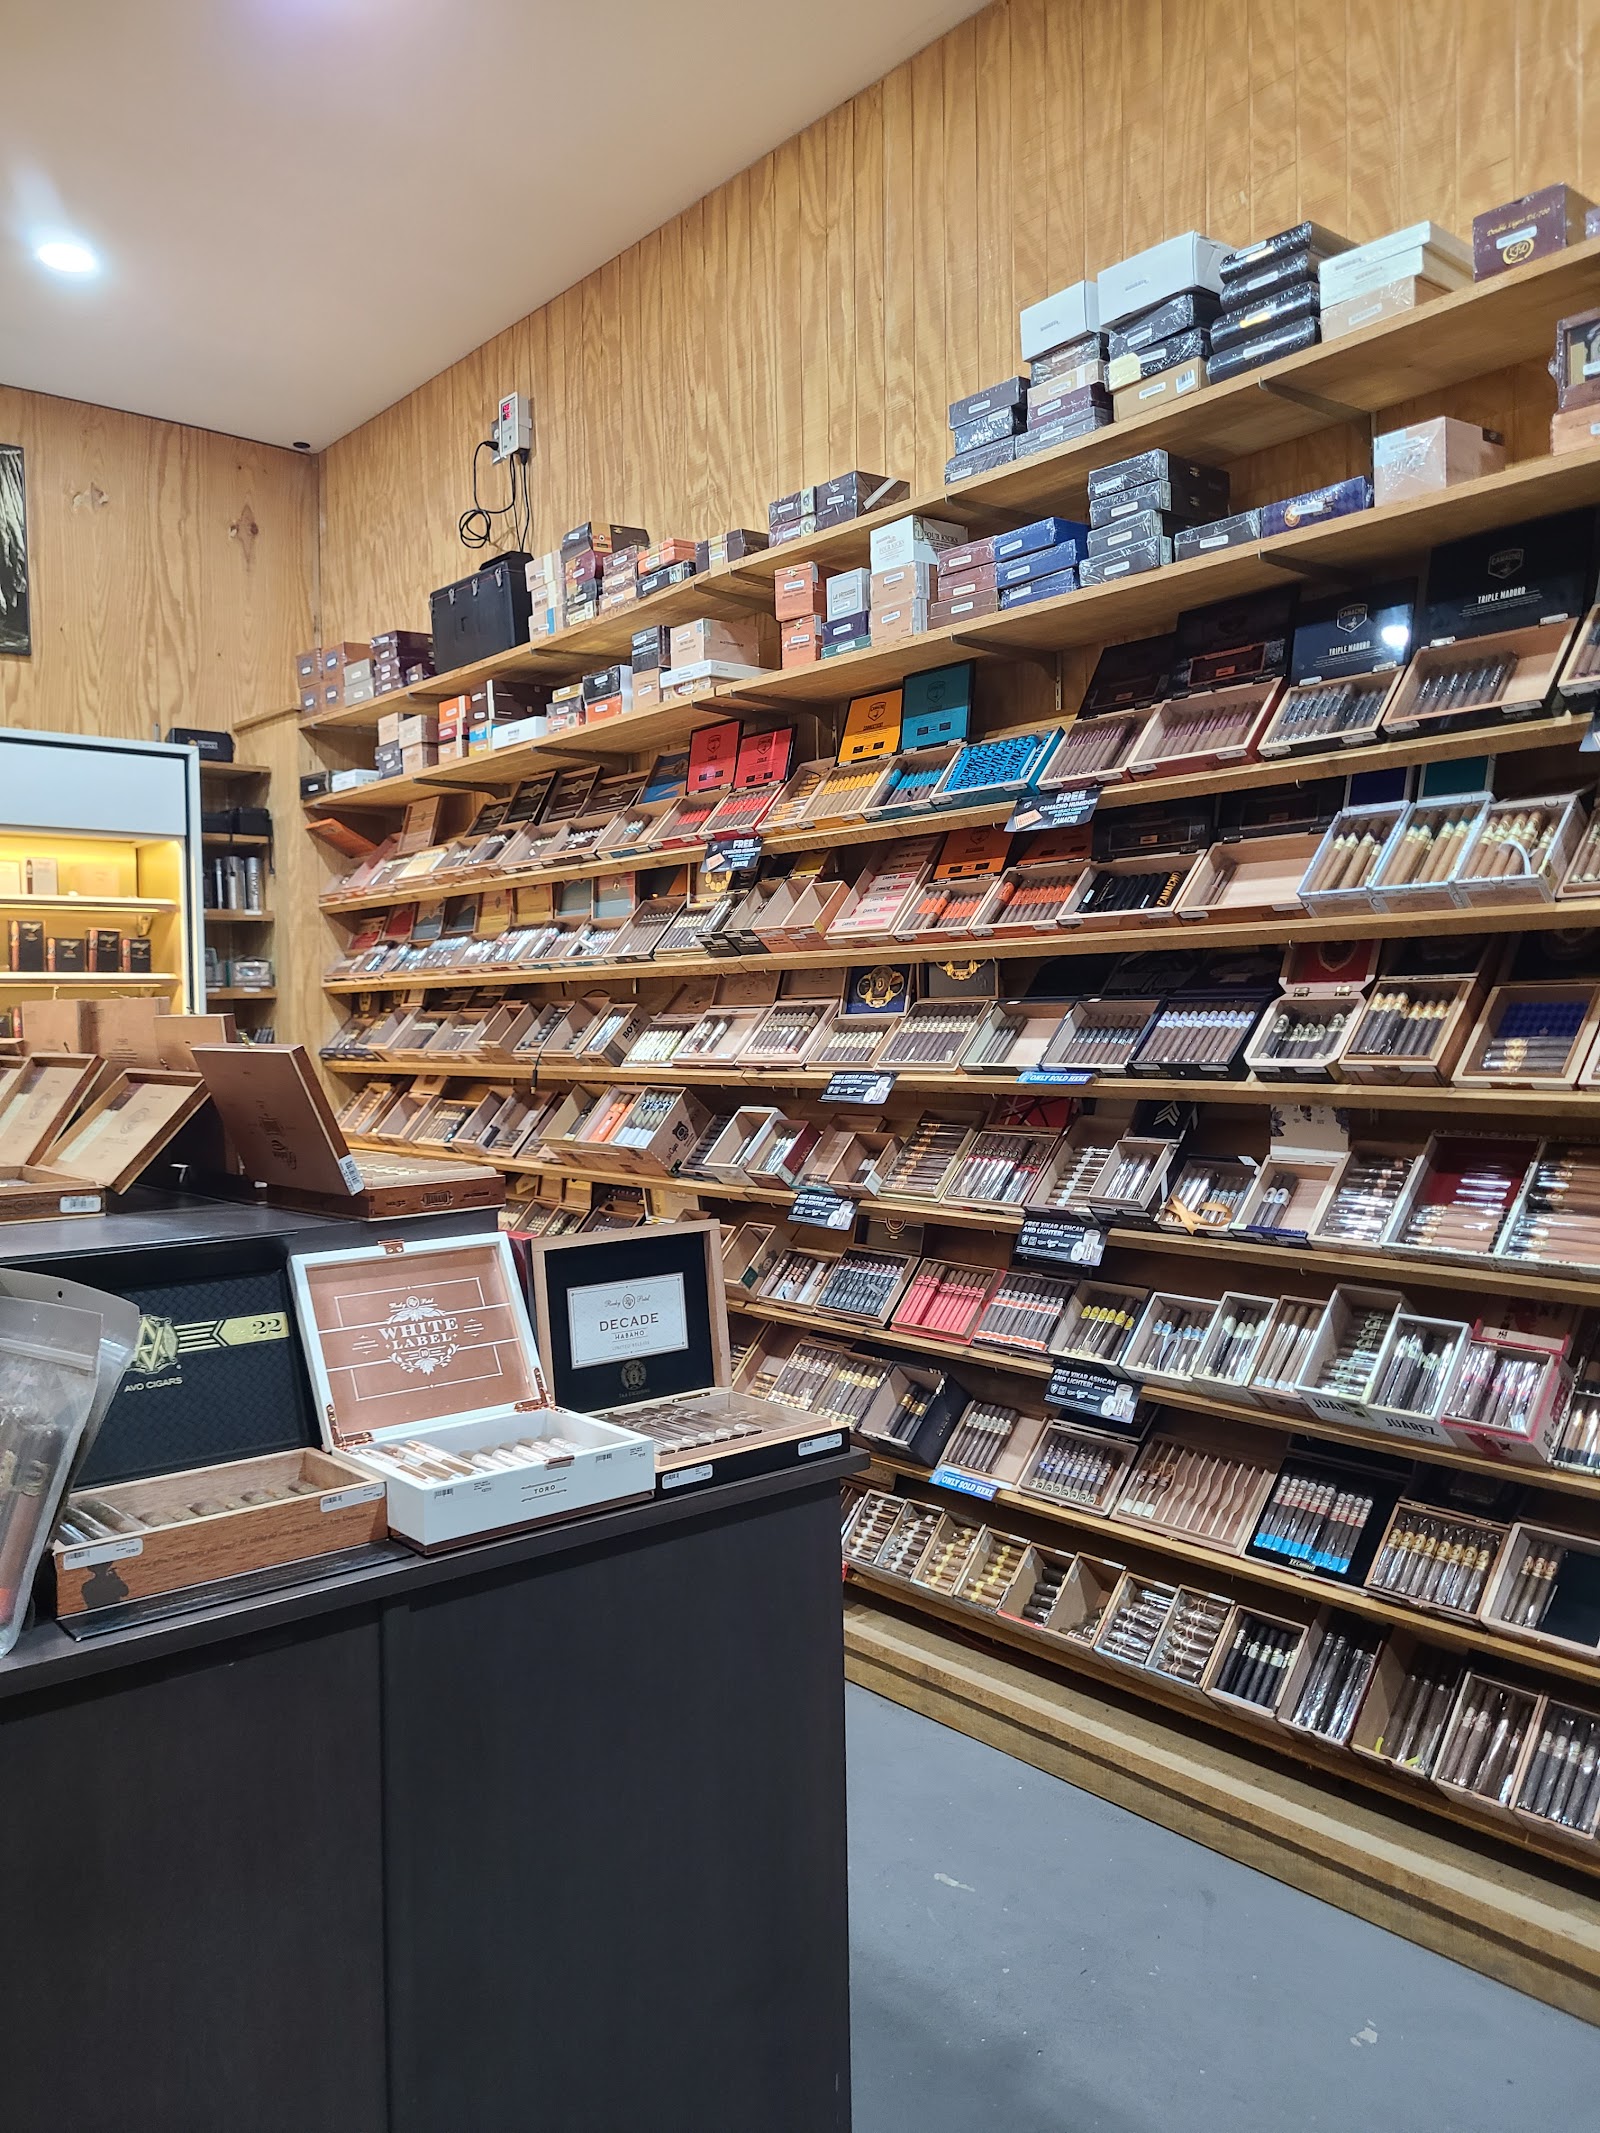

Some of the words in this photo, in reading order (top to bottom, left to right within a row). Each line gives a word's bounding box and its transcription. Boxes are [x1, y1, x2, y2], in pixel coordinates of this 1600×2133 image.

[1477, 592, 1499, 604] TRIPLE
[1500, 586, 1526, 600] MADURO
[1340, 606, 1366, 619] CAMACHO
[1329, 645, 1348, 656] TRIPLE
[1348, 640, 1371, 653] MADURO
[1056, 790, 1087, 804] FREE
[1039, 803, 1068, 812] CAMACHO
[733, 839, 754, 849] FREE
[1156, 871, 1181, 907] CAMACHO
[1060, 1224, 1085, 1233] ASHCAN
[253, 1318, 282, 1335] 22
[378, 1318, 458, 1340] WHITE
[600, 1312, 659, 1332] DECADE
[392, 1332, 452, 1350] LABEL
[615, 1330, 645, 1340] HABANO
[124, 1383, 144, 1393] AVO
[146, 1376, 183, 1390] CIGARS
[1054, 1368, 1071, 1378] FREE
[1089, 1375, 1118, 1387] ASHCAN
[534, 1484, 556, 1494] TORO
[942, 1476, 960, 1487] ONLY
[958, 1480, 976, 1492] SOLD
[975, 1485, 994, 1497] HERE
